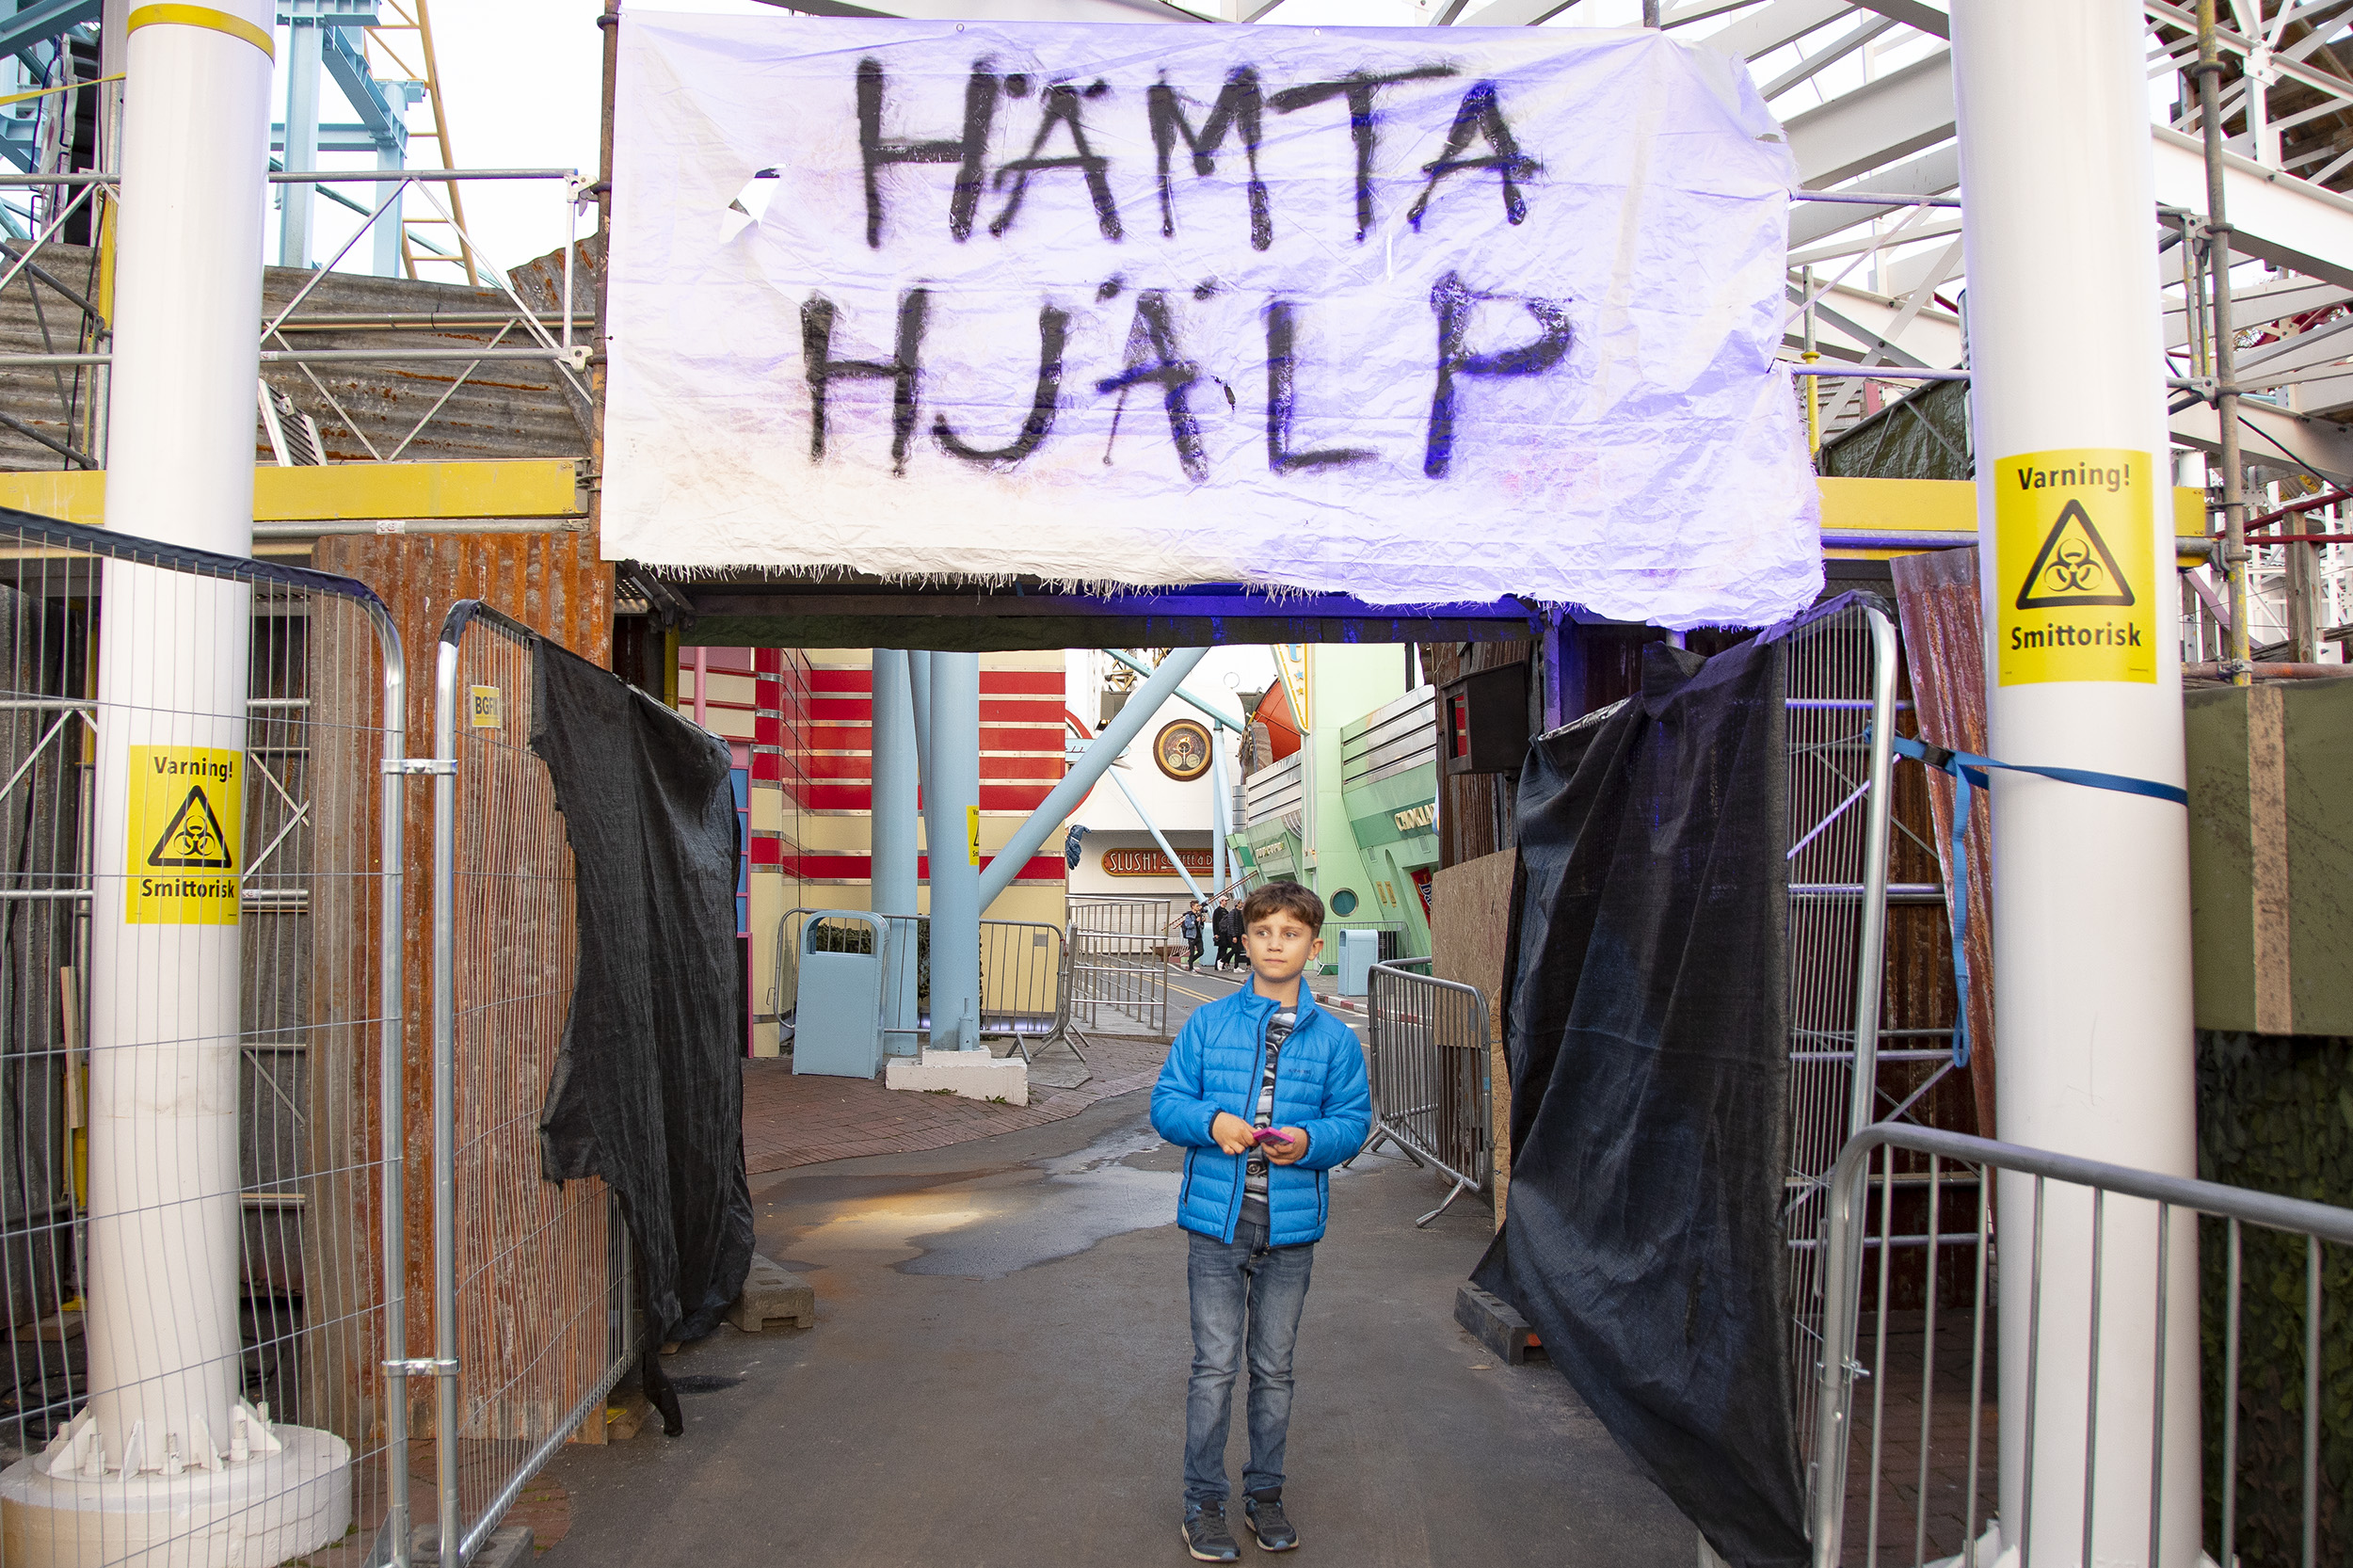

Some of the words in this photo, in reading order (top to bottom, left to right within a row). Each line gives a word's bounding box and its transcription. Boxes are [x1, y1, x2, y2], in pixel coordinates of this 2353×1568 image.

[856, 55, 1544, 250] HÄMTA
[800, 270, 1574, 483] HJÄLP
[2017, 461, 2131, 493] Varning!
[2010, 621, 2143, 650] Smittorisk
[153, 756, 233, 783] Varning!
[141, 877, 235, 899] Smittorisk
